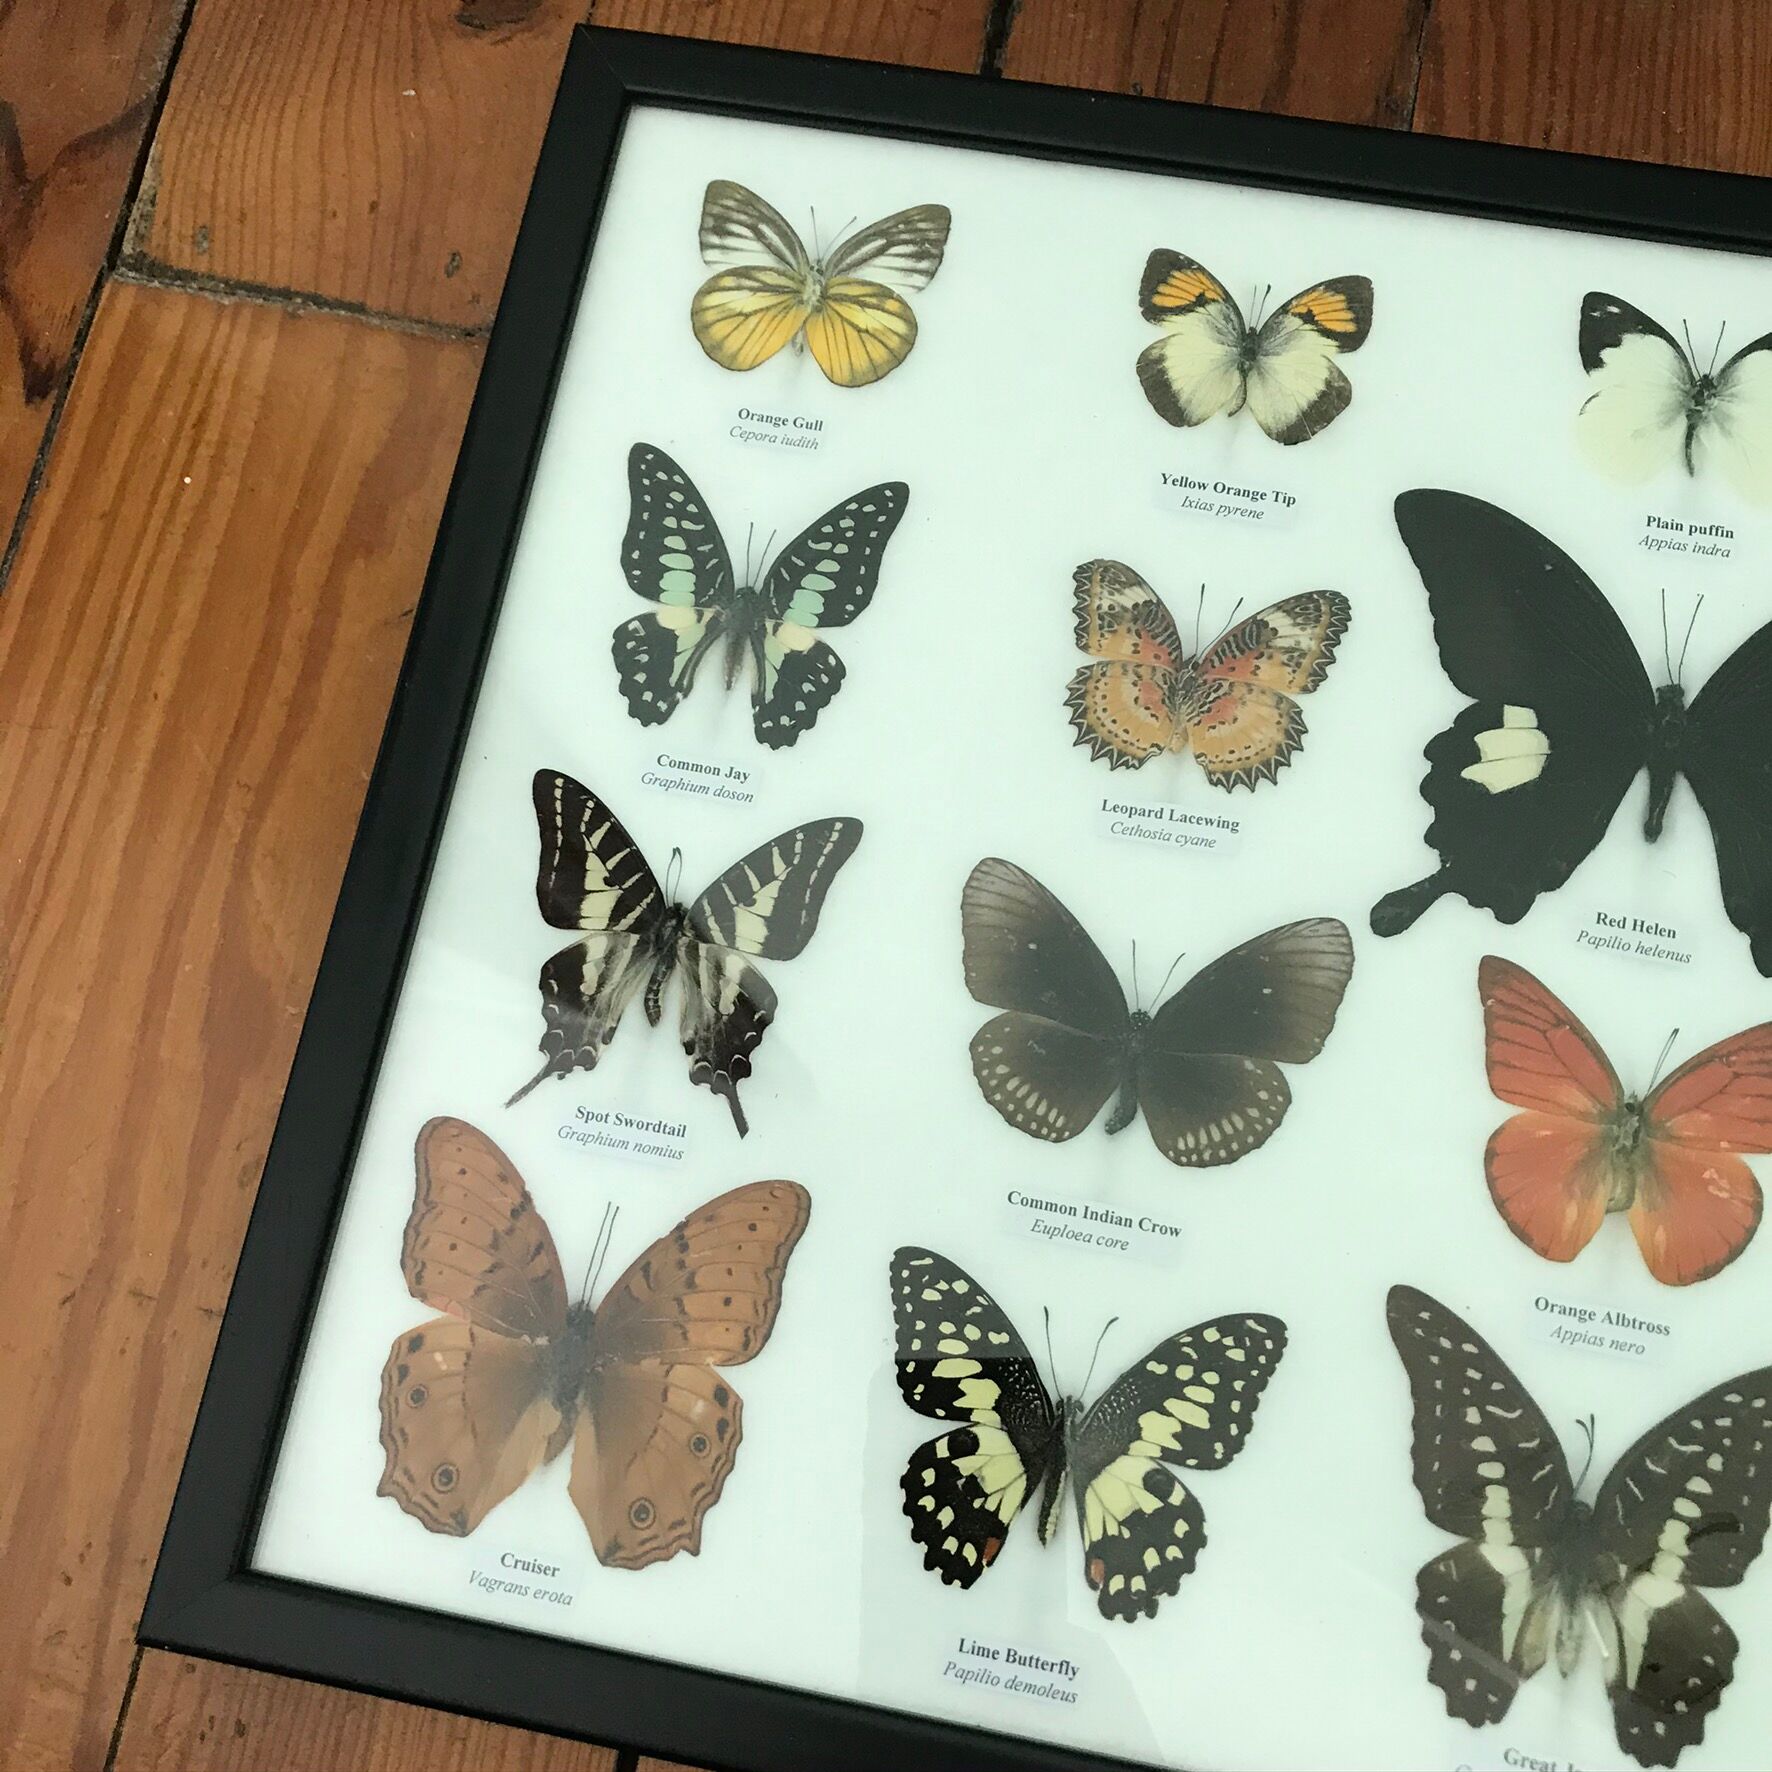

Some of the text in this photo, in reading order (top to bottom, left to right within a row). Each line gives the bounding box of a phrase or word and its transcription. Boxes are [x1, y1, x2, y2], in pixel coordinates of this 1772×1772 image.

[738, 408, 823, 431] Orange Gull
[730, 426, 819, 450] Cepora iudith
[1161, 473, 1296, 507] Yellow Orange Tip
[1181, 496, 1264, 519] Ixias pyrene
[1647, 515, 1734, 539] Plain puffin
[1638, 534, 1731, 558] Appias indra
[657, 754, 750, 784] Common Jay
[641, 772, 754, 802] Graphium doson
[1102, 799, 1240, 833] Leopard Lacewing
[1110, 821, 1216, 848] Cethosia cyane
[1596, 912, 1676, 939] Red Helen
[1577, 930, 1692, 964] Papilio helenus
[576, 1105, 687, 1138] Spot Swordtail
[558, 1125, 684, 1160] Graphium nomius
[1007, 1190, 1182, 1238] Common Indian Crow
[1030, 1218, 1129, 1250] Euploea core
[1535, 1296, 1671, 1336] Orange Albtross
[1550, 1325, 1645, 1355] Appias nero
[500, 1552, 560, 1577] Cruiser
[469, 1569, 573, 1606] Vagrans erota
[959, 1638, 1080, 1681] Lime Butterfly
[944, 1661, 1078, 1704] Papilio demoleus
